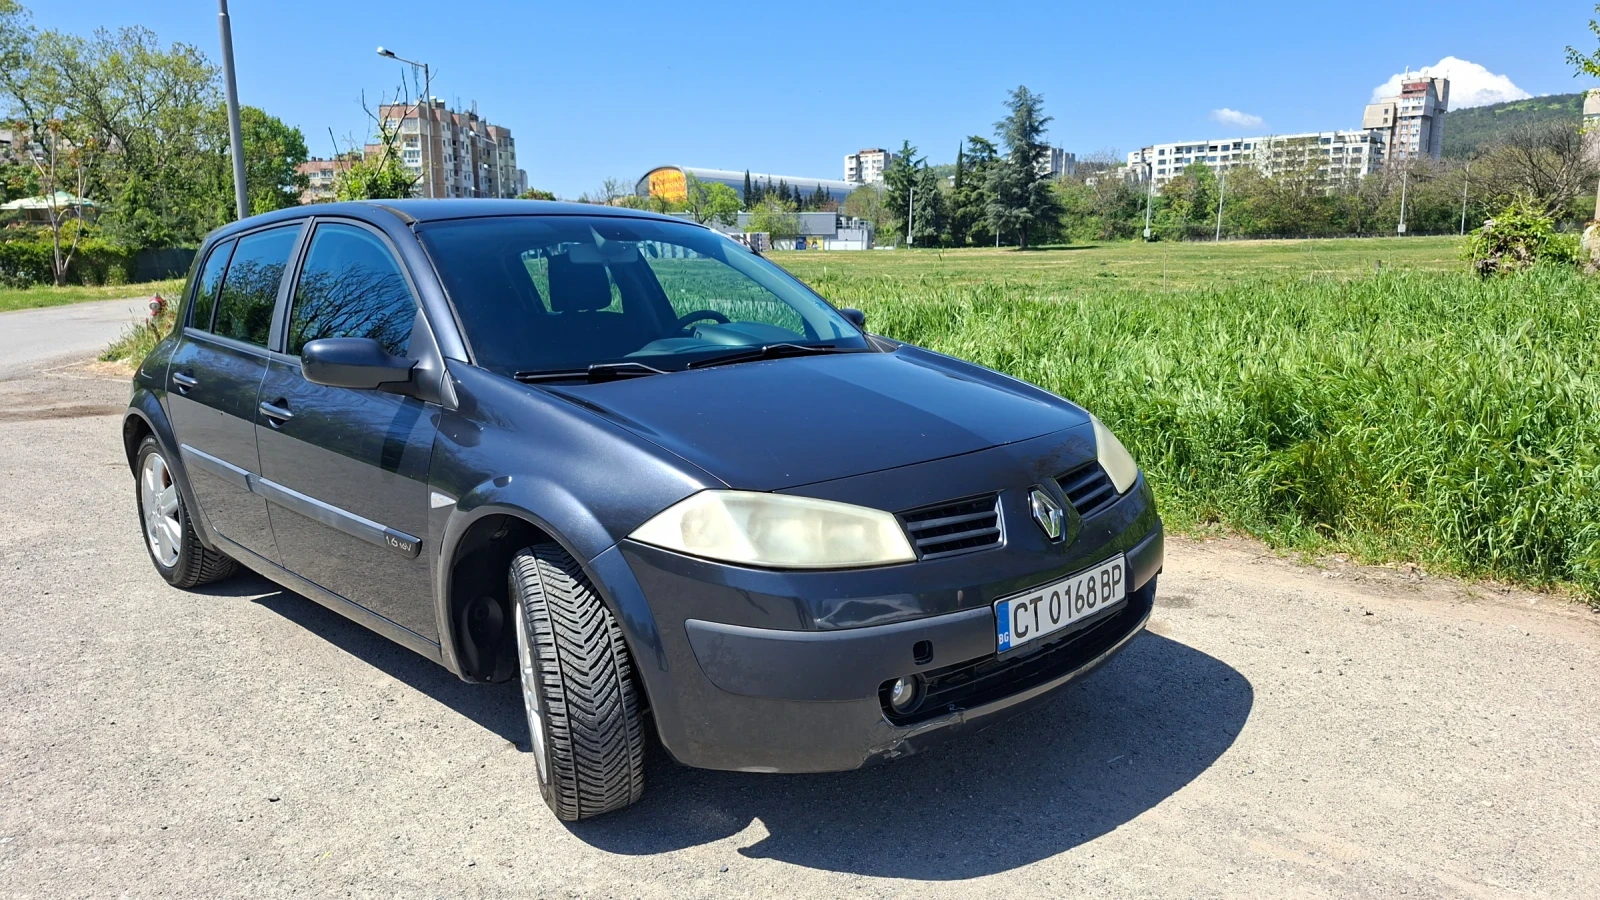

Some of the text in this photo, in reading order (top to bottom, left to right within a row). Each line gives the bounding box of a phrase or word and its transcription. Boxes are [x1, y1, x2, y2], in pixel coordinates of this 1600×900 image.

[1013, 564, 1122, 639] CT 0168 BP
[998, 631, 1009, 645] BG
